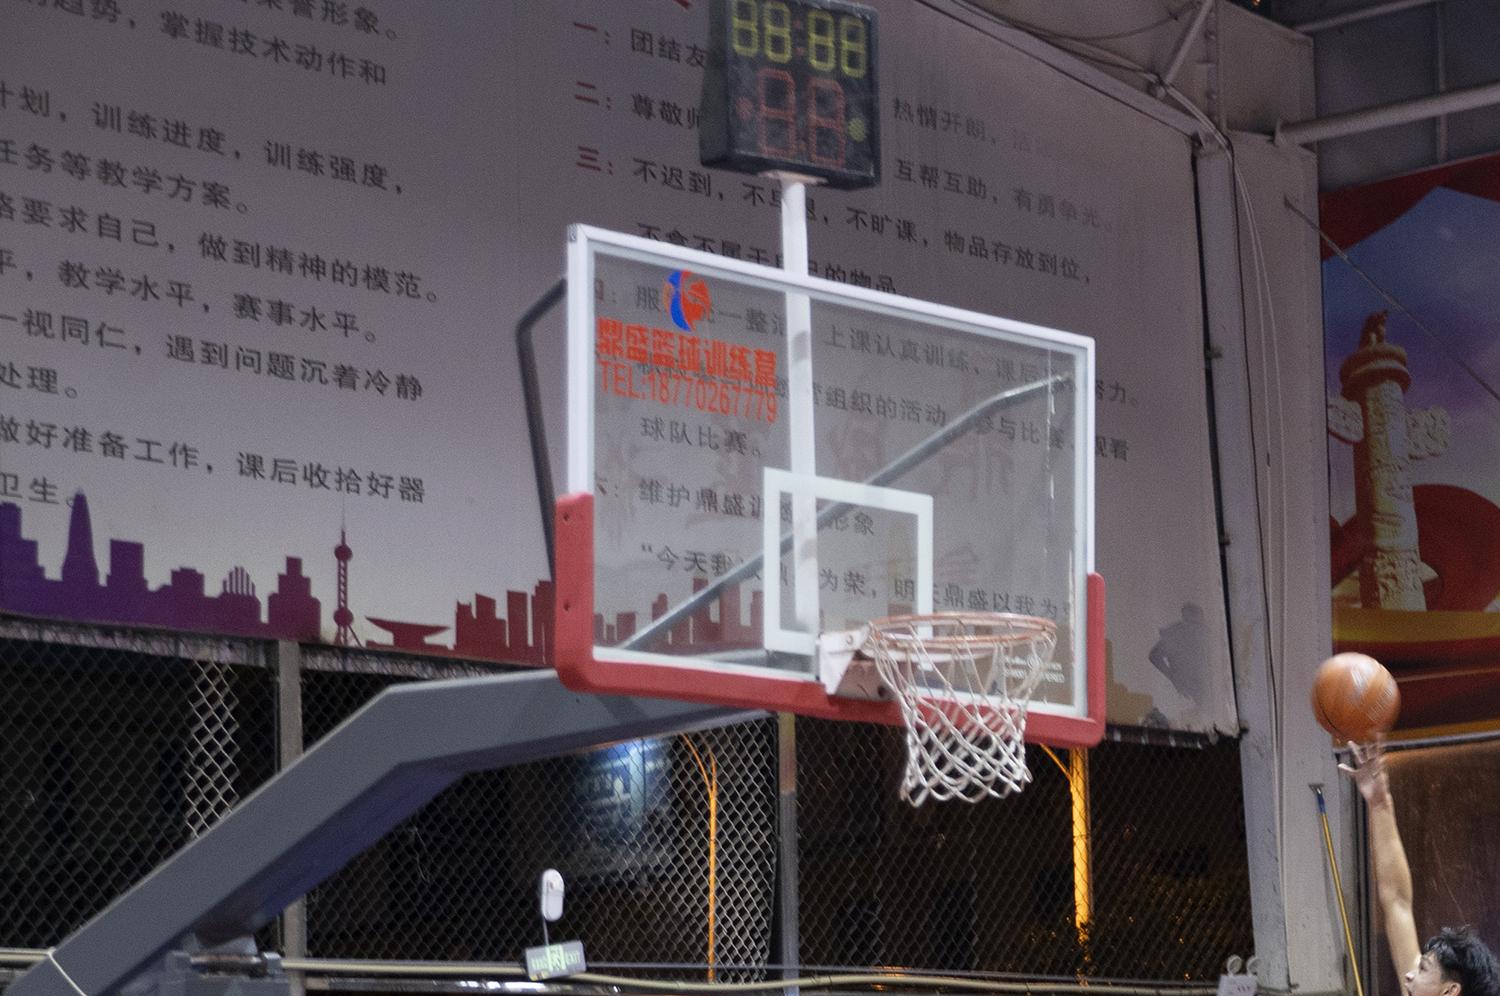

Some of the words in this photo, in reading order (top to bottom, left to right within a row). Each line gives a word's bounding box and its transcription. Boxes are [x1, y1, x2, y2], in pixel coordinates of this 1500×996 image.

[0, 308, 423, 402] 一视同仁，遇到问题沉着冷静
[595, 318, 778, 388] 鼎盛篮球训练营
[641, 416, 762, 457] 球队比赛。
